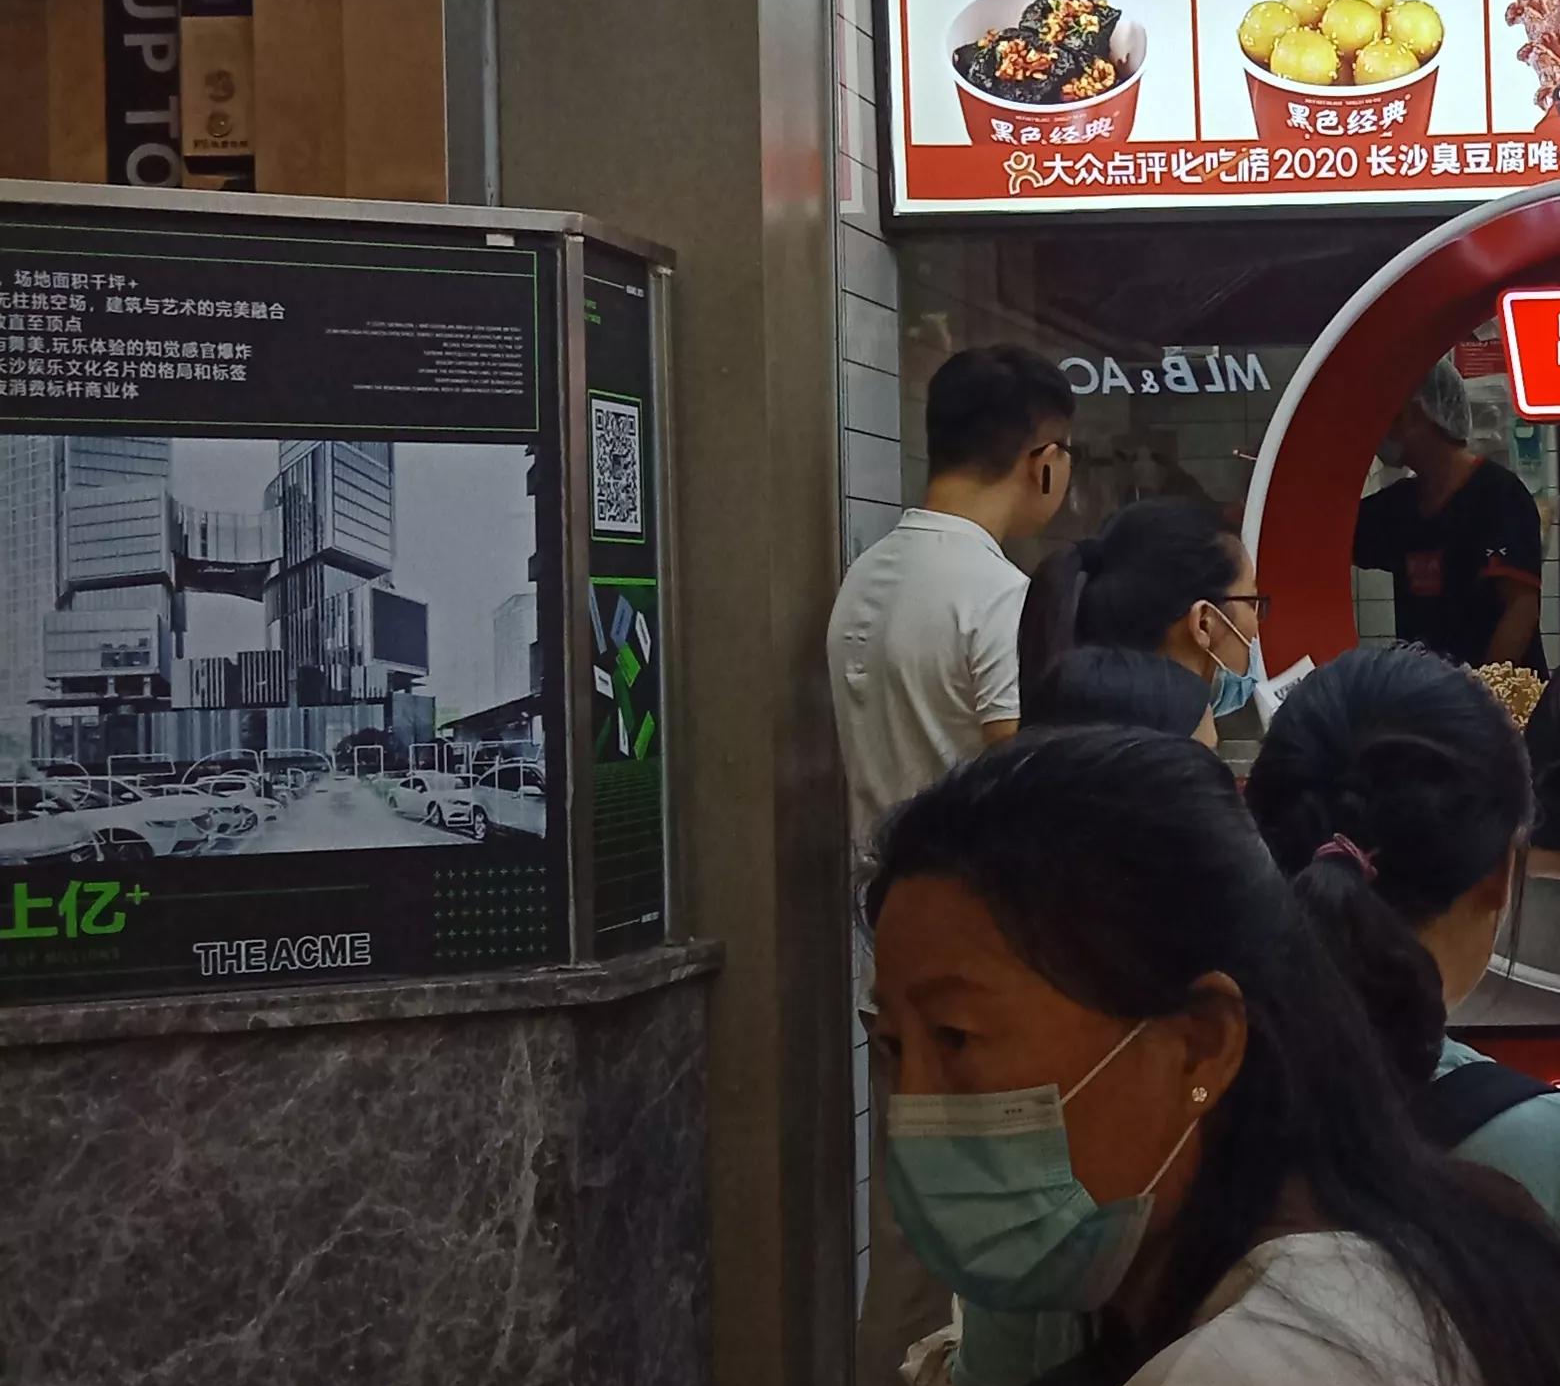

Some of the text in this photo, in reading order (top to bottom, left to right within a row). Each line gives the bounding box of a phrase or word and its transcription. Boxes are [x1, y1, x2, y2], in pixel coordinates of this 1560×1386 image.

[990, 116, 1115, 146] 黑色经典
[1286, 100, 1408, 140] 黑色经典
[193, 932, 372, 976] THE ACME
